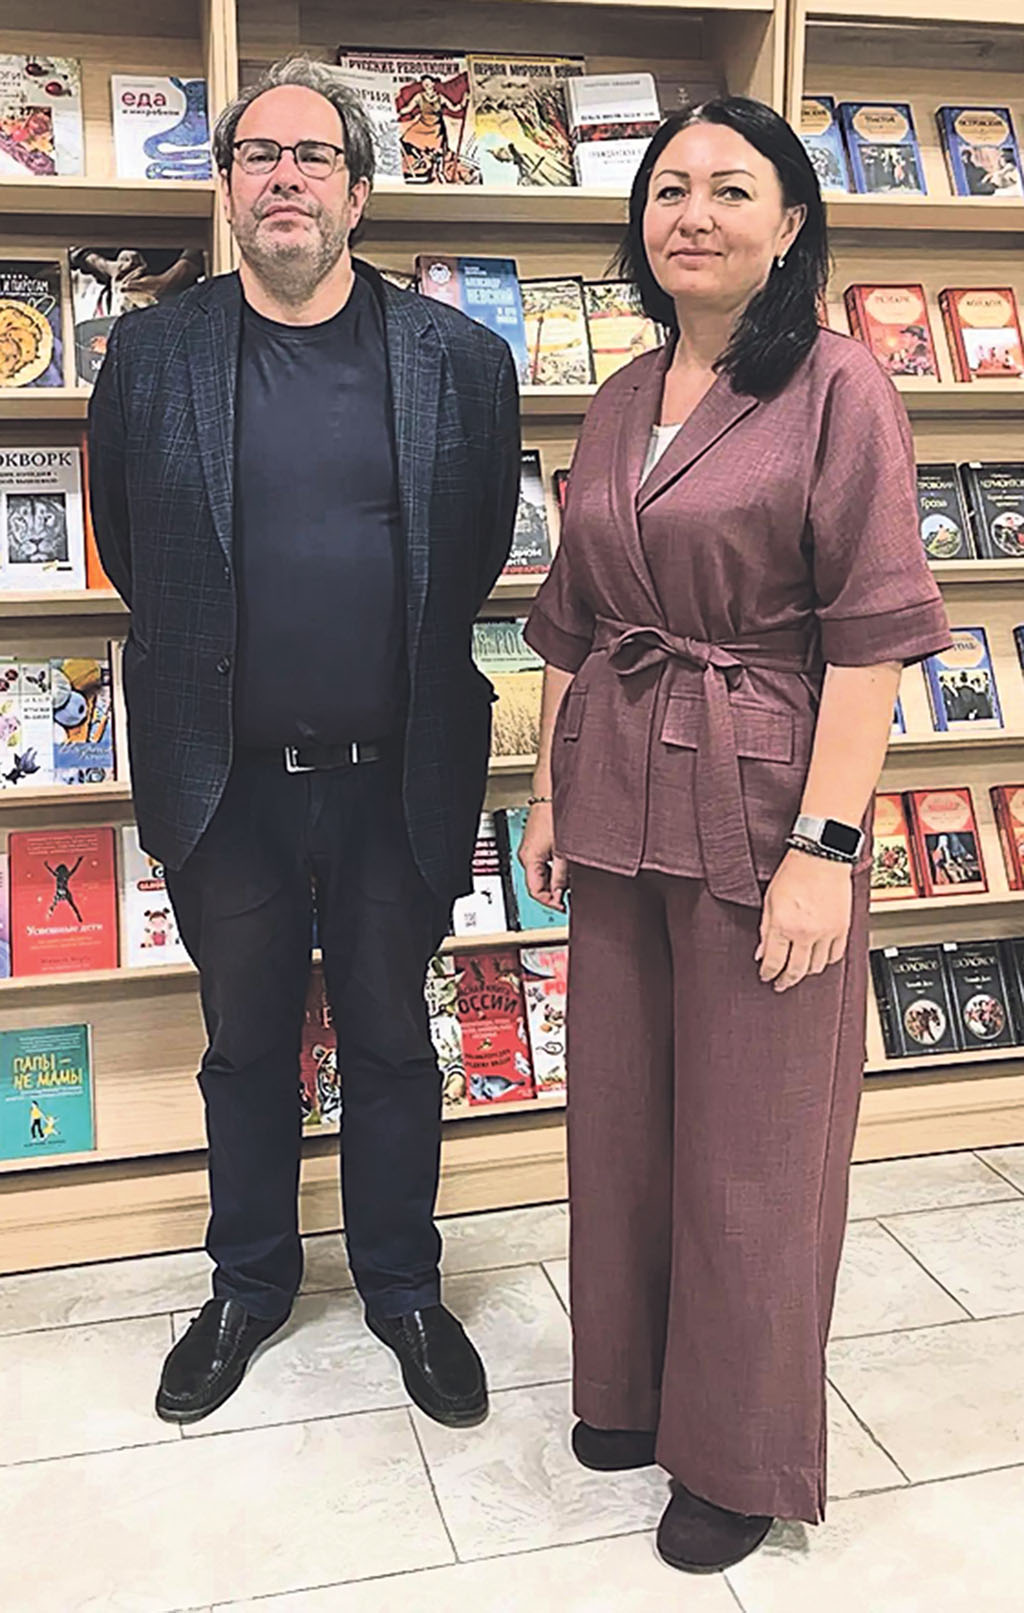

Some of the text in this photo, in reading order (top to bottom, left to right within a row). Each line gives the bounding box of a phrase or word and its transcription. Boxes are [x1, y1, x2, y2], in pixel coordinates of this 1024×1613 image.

[348, 59, 460, 76] РУССКИЕ РЕВОЛЮЦИИ
[473, 62, 508, 76] ПЕРВАЯ
[509, 63, 552, 78] МИРОВАЯ
[121, 90, 167, 107] еда
[11, 279, 49, 294] ПИРОГАМ
[13, 1052, 56, 1074] ПАПЫ
[13, 1072, 34, 1091] НЕ
[36, 1067, 84, 1088] МАМЫ
